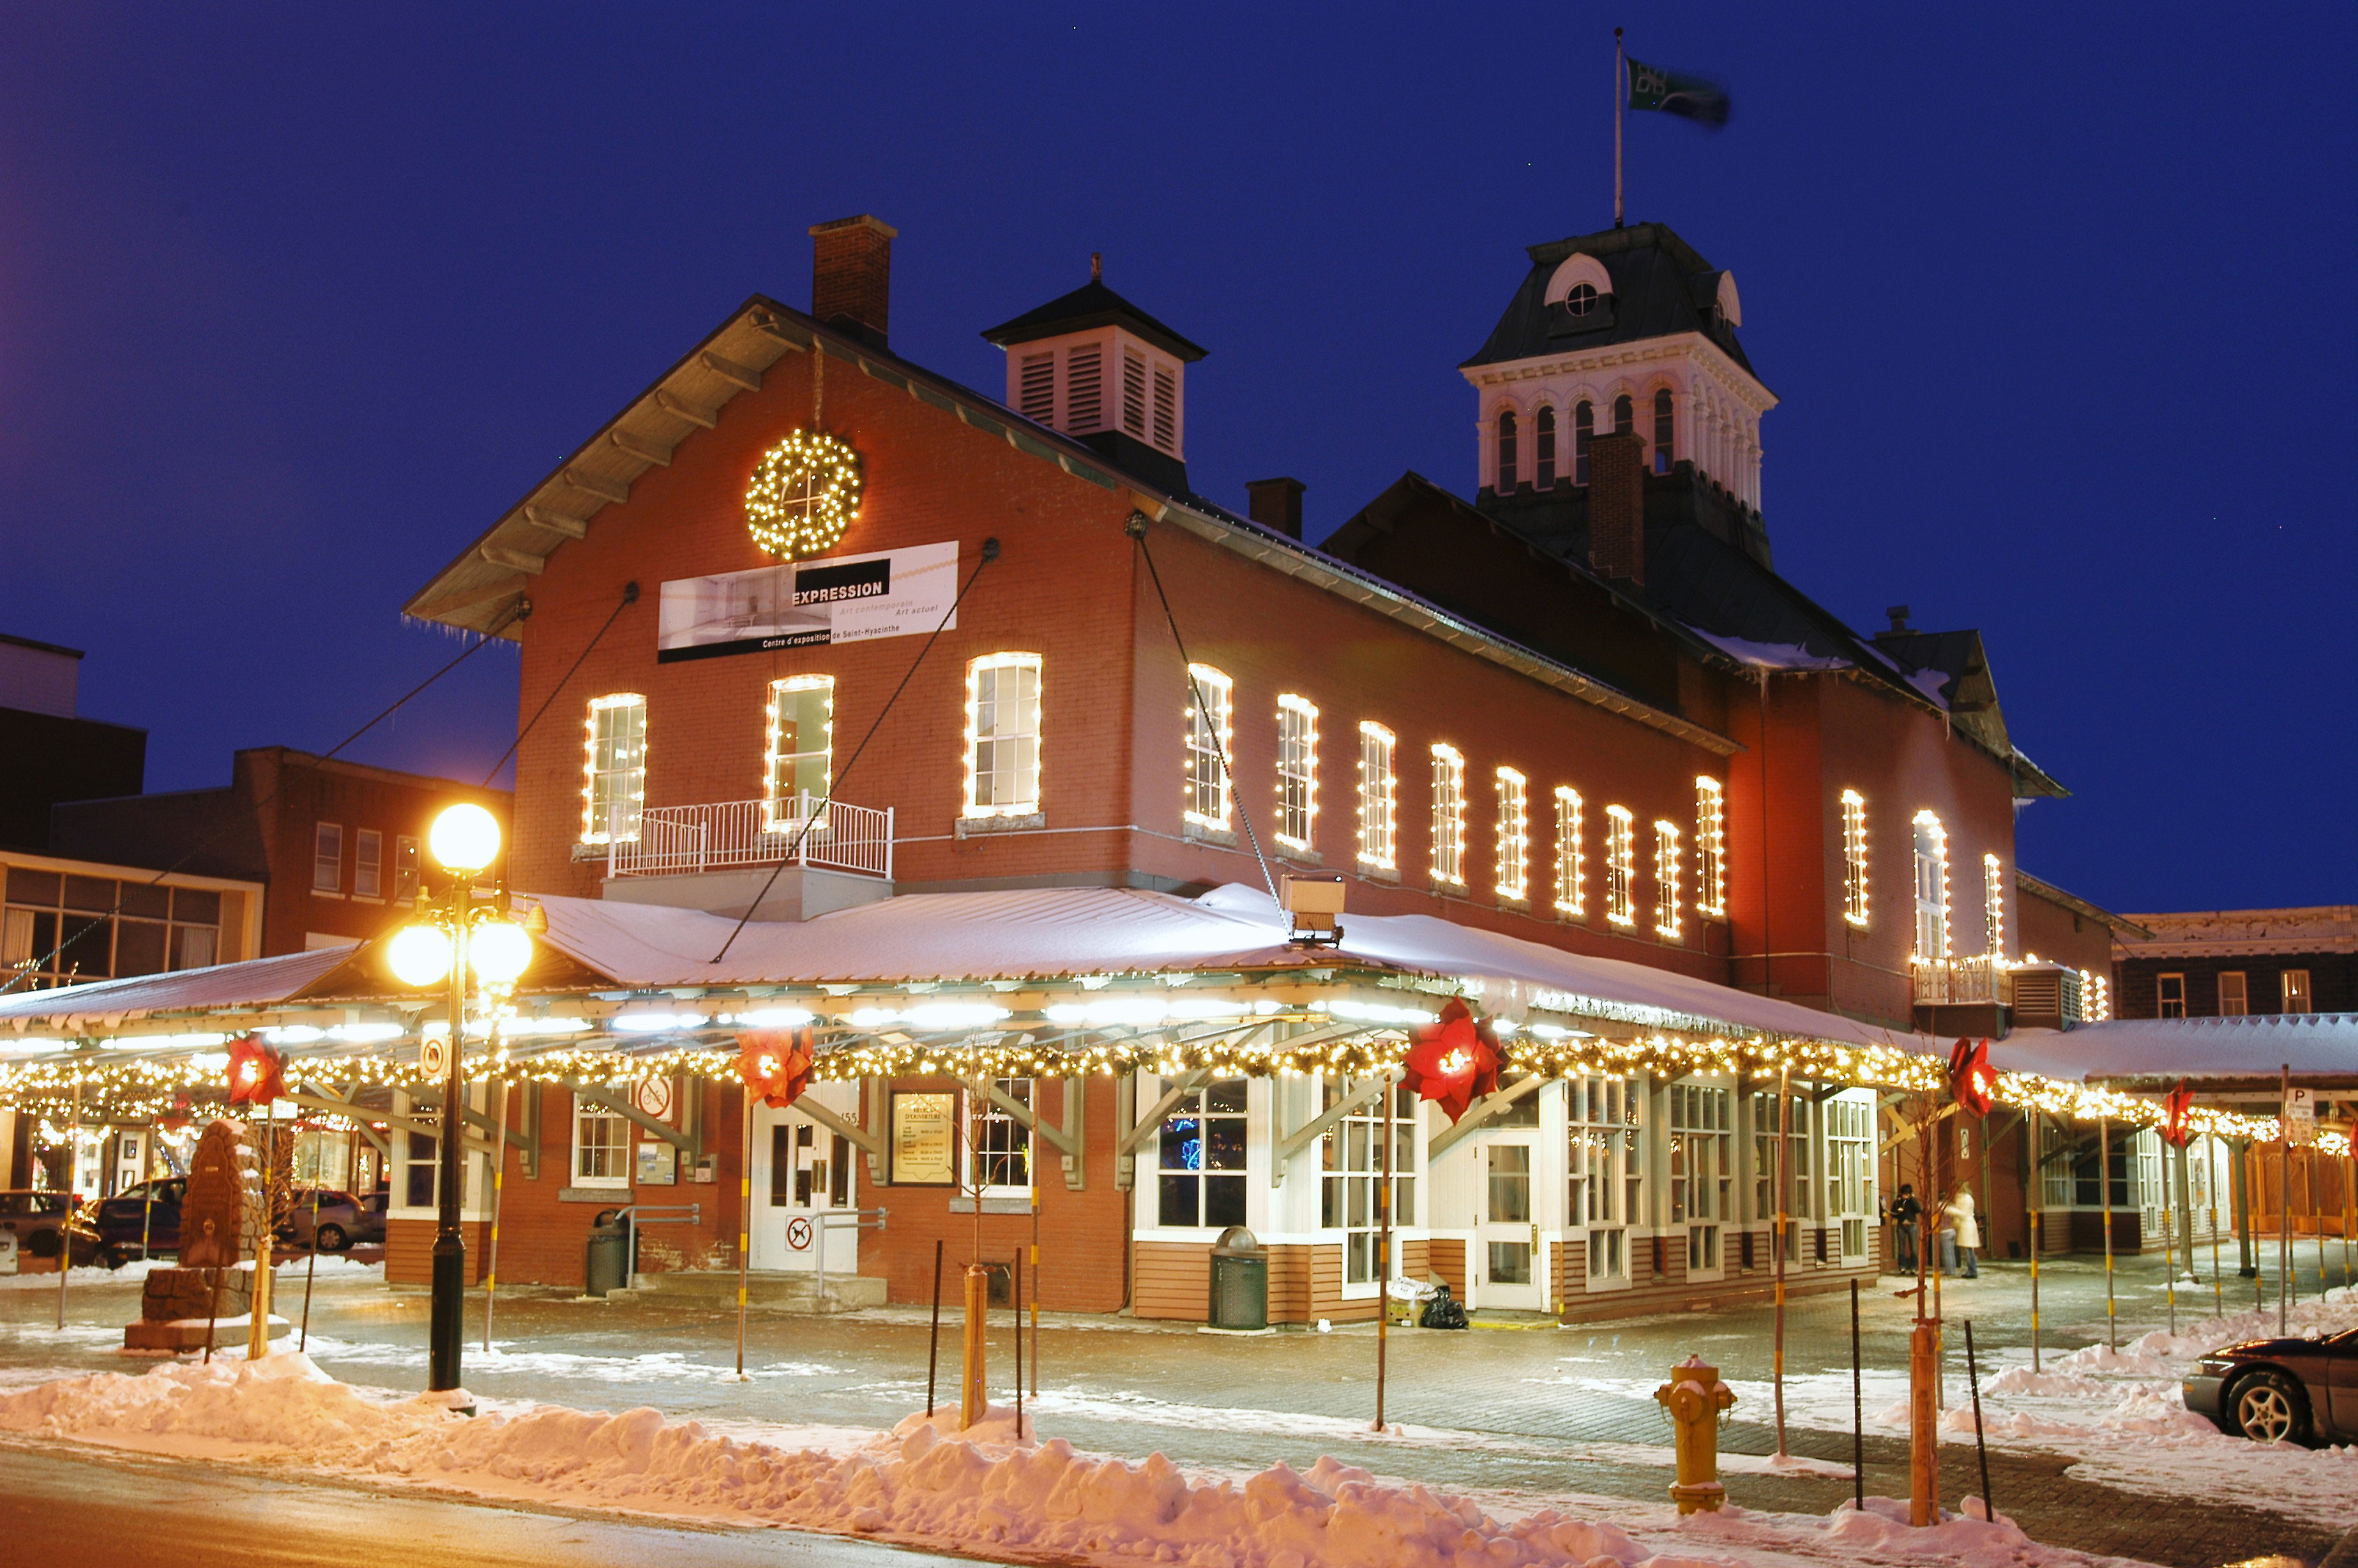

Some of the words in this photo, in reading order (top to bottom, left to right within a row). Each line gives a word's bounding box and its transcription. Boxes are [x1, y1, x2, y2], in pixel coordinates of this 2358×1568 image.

[792, 581, 882, 605] EXPRESSION
[840, 607, 852, 615] Art
[856, 600, 913, 614] contemporain
[895, 608, 908, 616] Art
[912, 605, 939, 614] actuel
[763, 639, 785, 648] Centre
[843, 625, 900, 638] Saint-Hyacinthe
[2295, 1090, 2305, 1102] P
